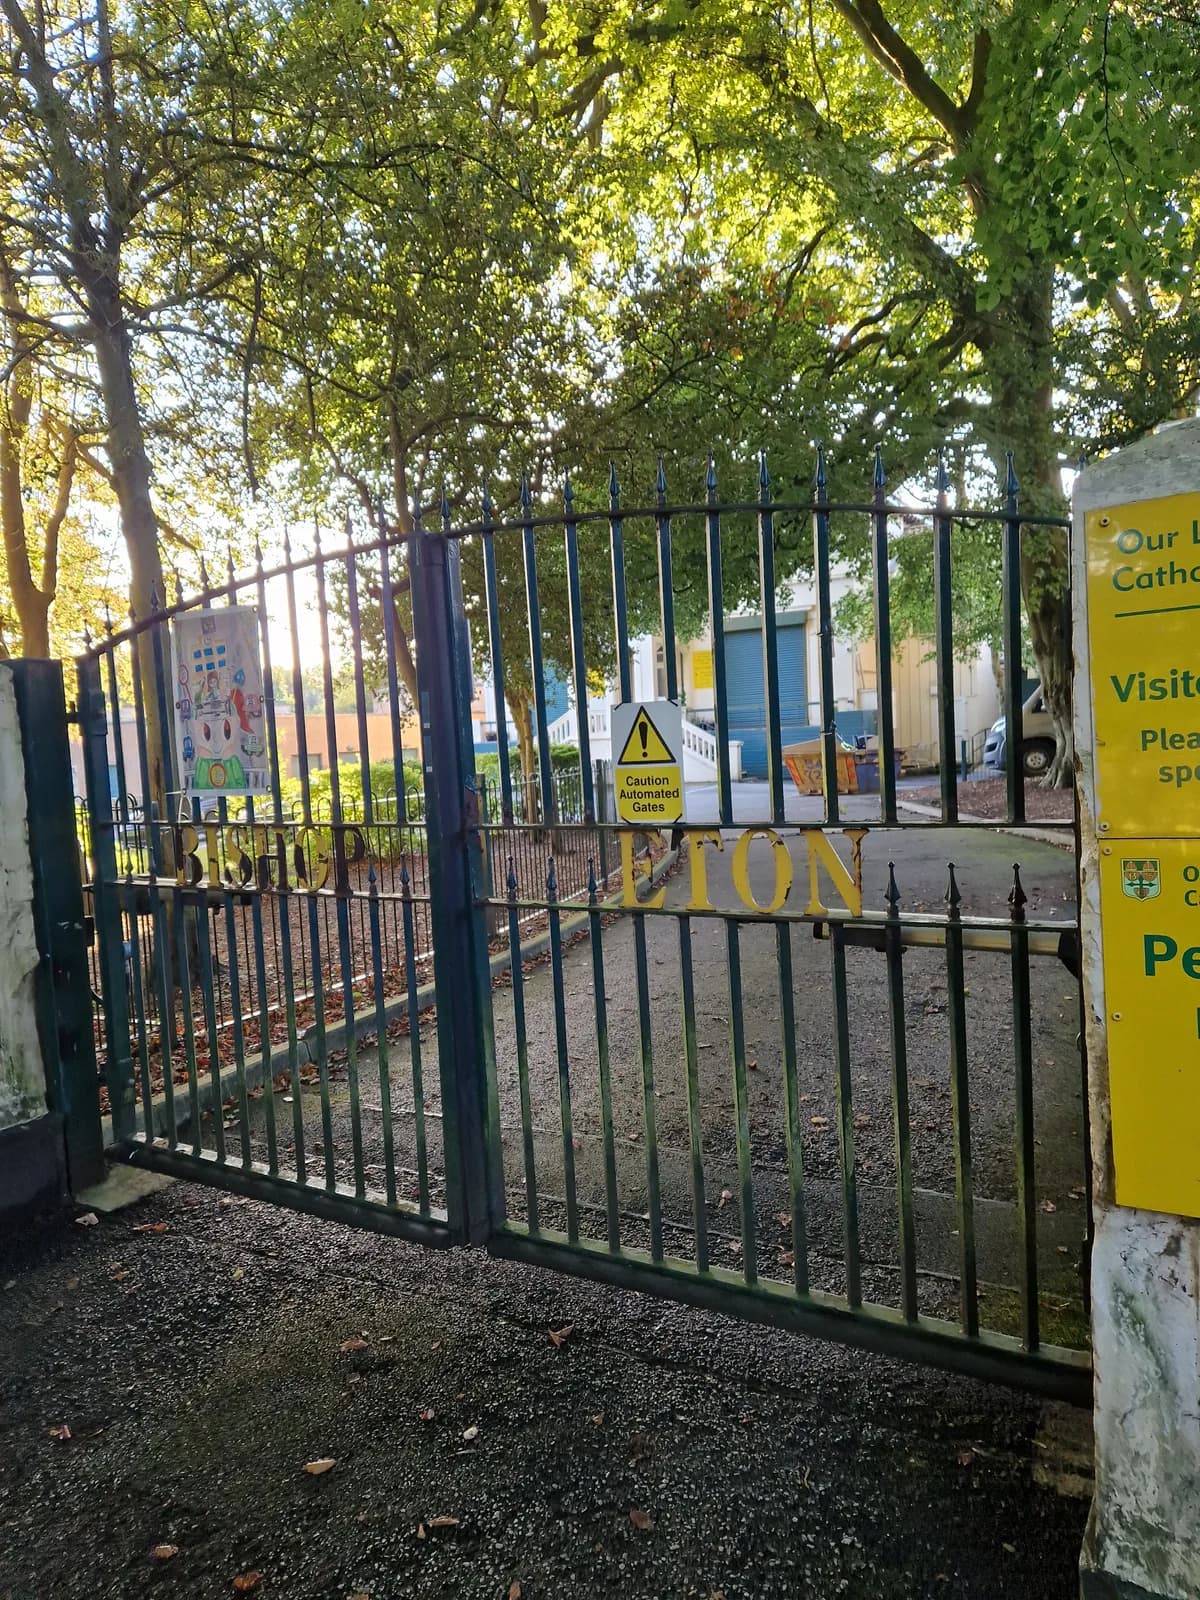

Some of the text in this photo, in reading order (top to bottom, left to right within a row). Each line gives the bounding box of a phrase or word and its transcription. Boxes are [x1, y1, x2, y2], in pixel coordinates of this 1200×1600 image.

[1117, 529, 1179, 555] Our
[625, 775, 669, 786] Caution
[620, 788, 679, 800] Automated
[632, 802, 665, 812] Gates
[174, 824, 870, 917] BISHOP ETON
